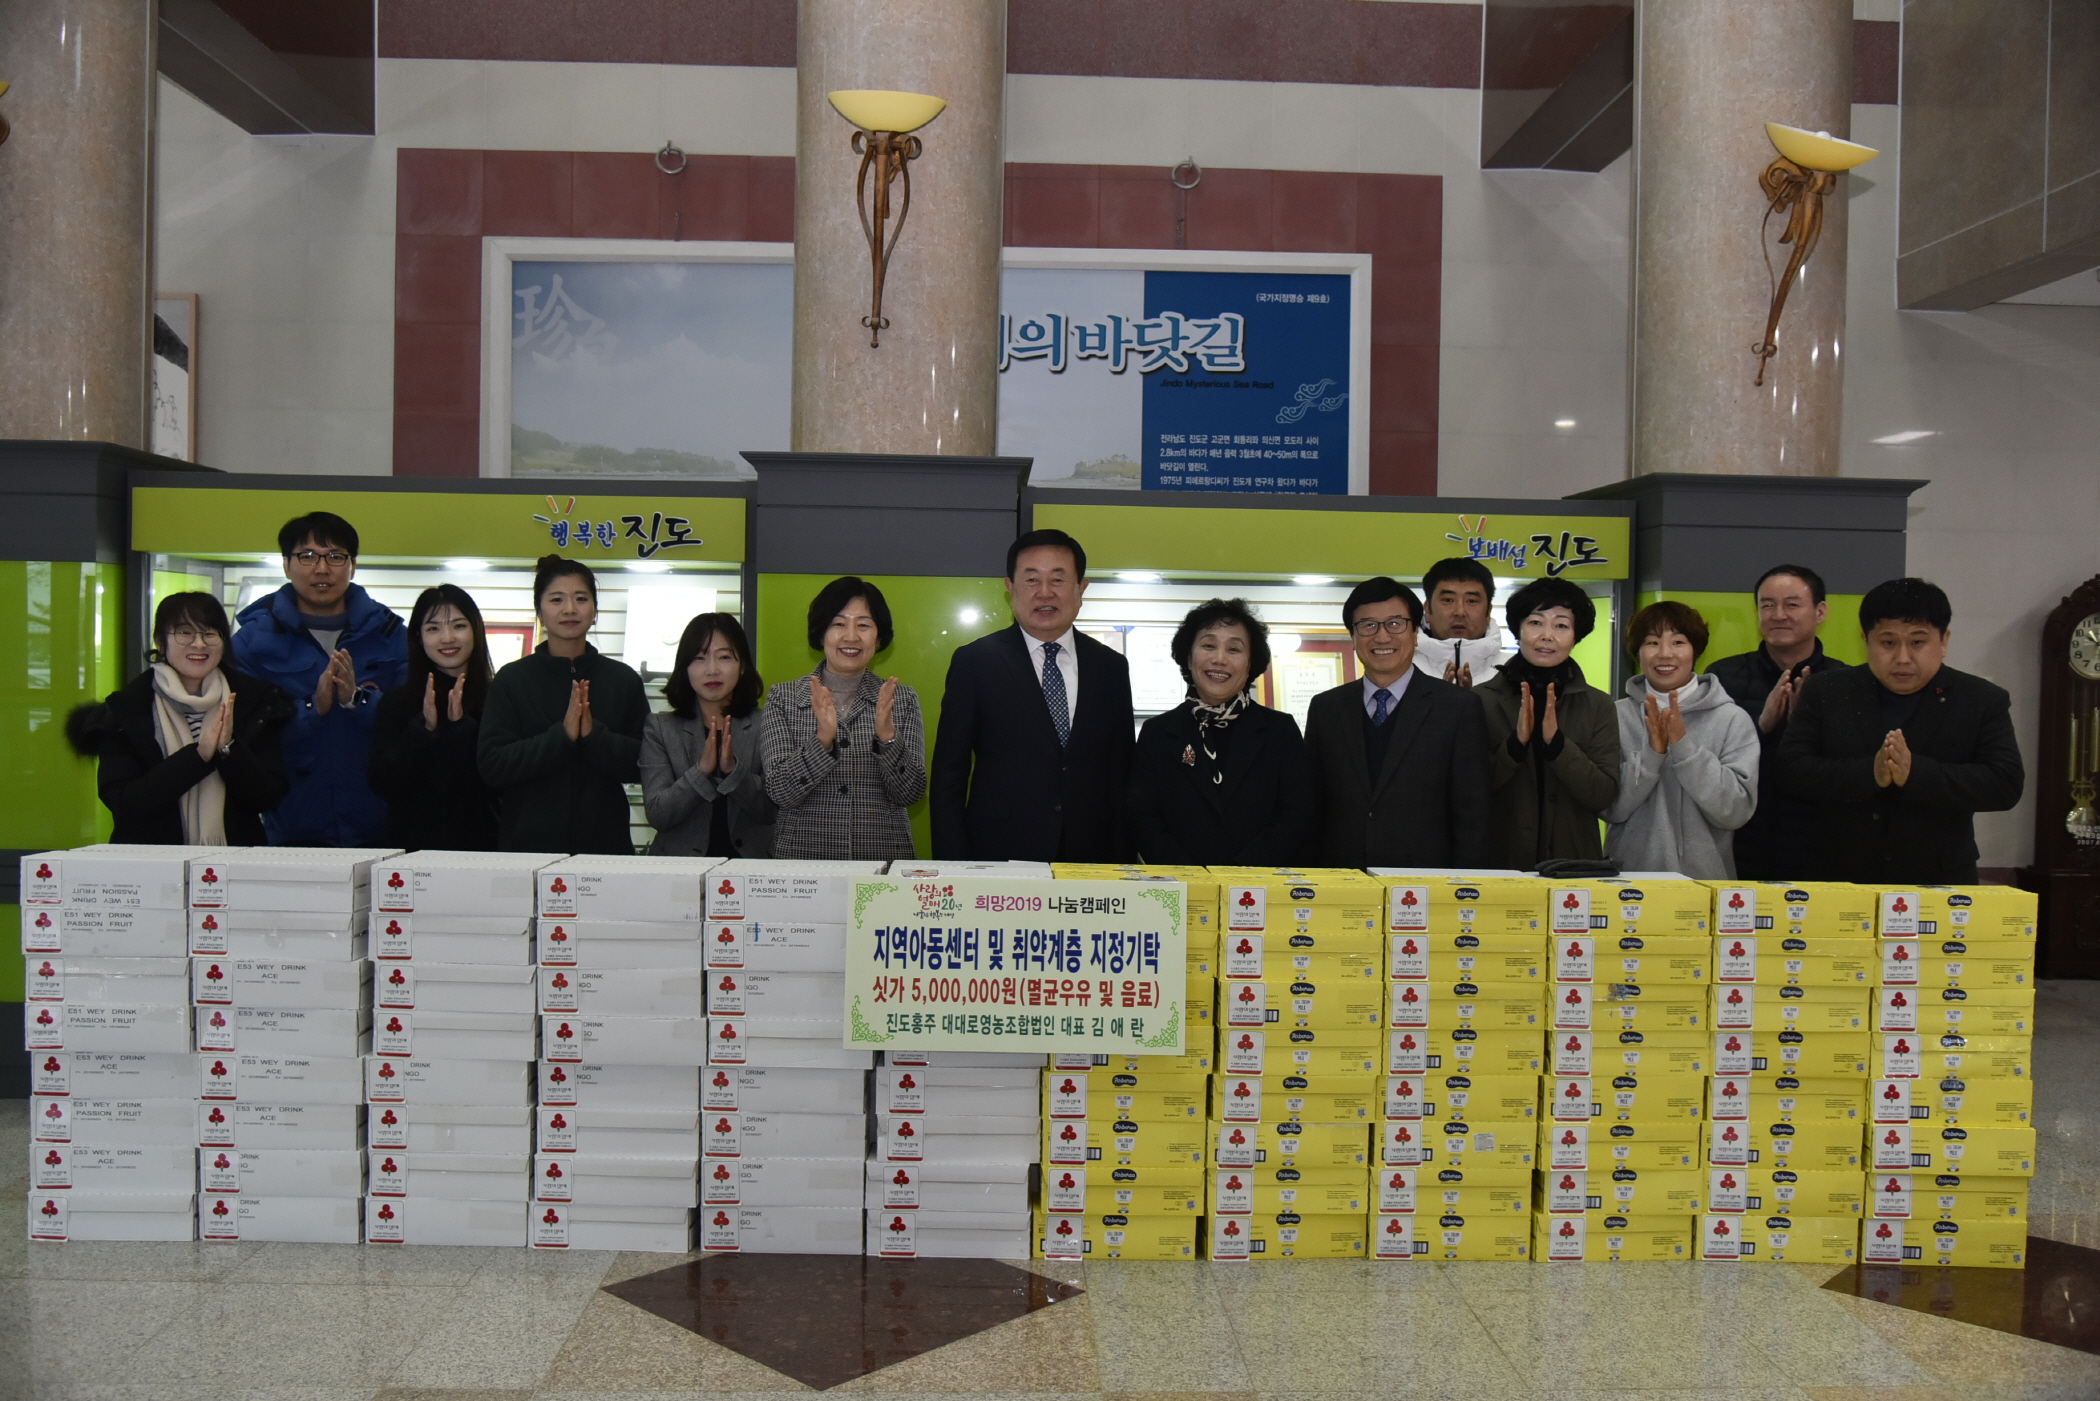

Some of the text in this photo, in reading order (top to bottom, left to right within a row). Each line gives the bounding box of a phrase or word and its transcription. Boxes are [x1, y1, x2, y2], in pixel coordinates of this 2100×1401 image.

[1160, 379, 1274, 389] Jindo Mysterious Sea Road
[1161, 434, 1186, 443] 전라남도
[1189, 434, 1208, 444] 진도군
[1211, 435, 1230, 444] 고군면
[1262, 436, 1281, 445] 의신면
[1284, 436, 1303, 445] 모도리
[1306, 436, 1319, 445] 사이
[1188, 448, 1208, 457] 바다가
[1160, 462, 1185, 471] 바닷길이
[1160, 476, 1182, 485] 1975년
[1254, 477, 1274, 486] 연구차
[1299, 478, 1318, 487] 바다가
[550, 512, 702, 558] 행복한 진도
[1463, 532, 1608, 576] 보배섬 진도
[975, 895, 1125, 914] 희망2019 나눔캠페인
[873, 926, 1160, 974] 지역아동센터 및 취약계층 지정기탁
[872, 976, 1159, 1009] 싯가 5,000,000원(멸균우유 및 음료)
[886, 1013, 1144, 1038] 진도홍주 대대로영농조합법인 대표 김 애 란
